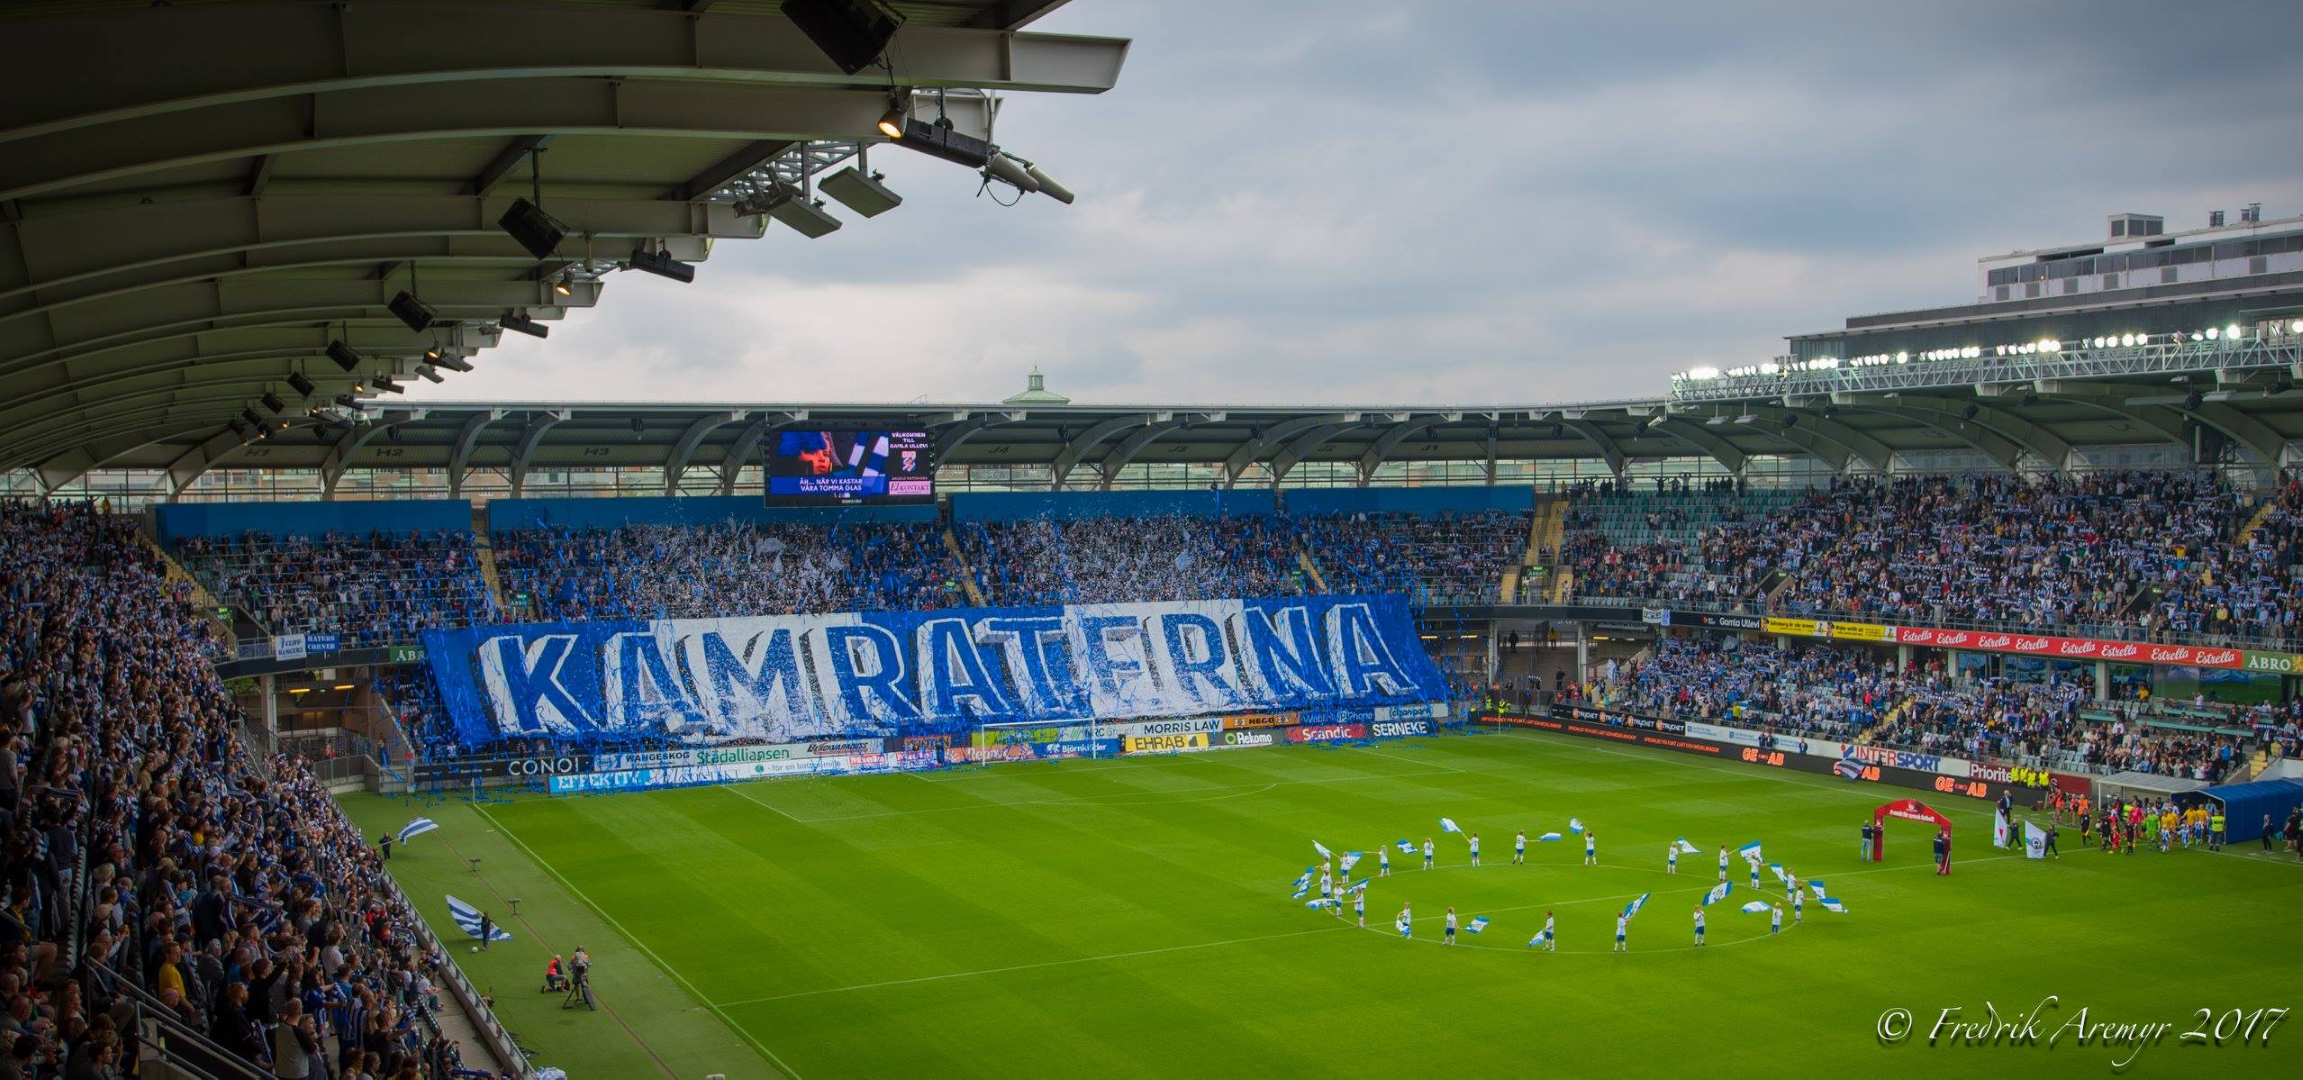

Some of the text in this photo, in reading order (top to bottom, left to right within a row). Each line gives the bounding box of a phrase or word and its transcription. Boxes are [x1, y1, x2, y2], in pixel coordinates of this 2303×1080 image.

[1903, 629, 2235, 664] Estrella Estrella Estrella Estrella Estrella Estrella Estrella Estrella
[482, 598, 1420, 742] KAMRATERNA
[2248, 653, 2292, 671] ÅBRO
[1144, 720, 1220, 735] MORRIS LAW
[1301, 725, 1352, 741] Scandic
[1373, 721, 1428, 737] SERNEKE
[1135, 735, 1184, 750] EHRAB
[1237, 731, 1272, 745] Rekomo
[625, 751, 690, 763] WANGESKOG
[696, 747, 790, 765] Städalliansen
[1856, 744, 1942, 772] INTERSPORT
[1970, 763, 2013, 783] Priorite
